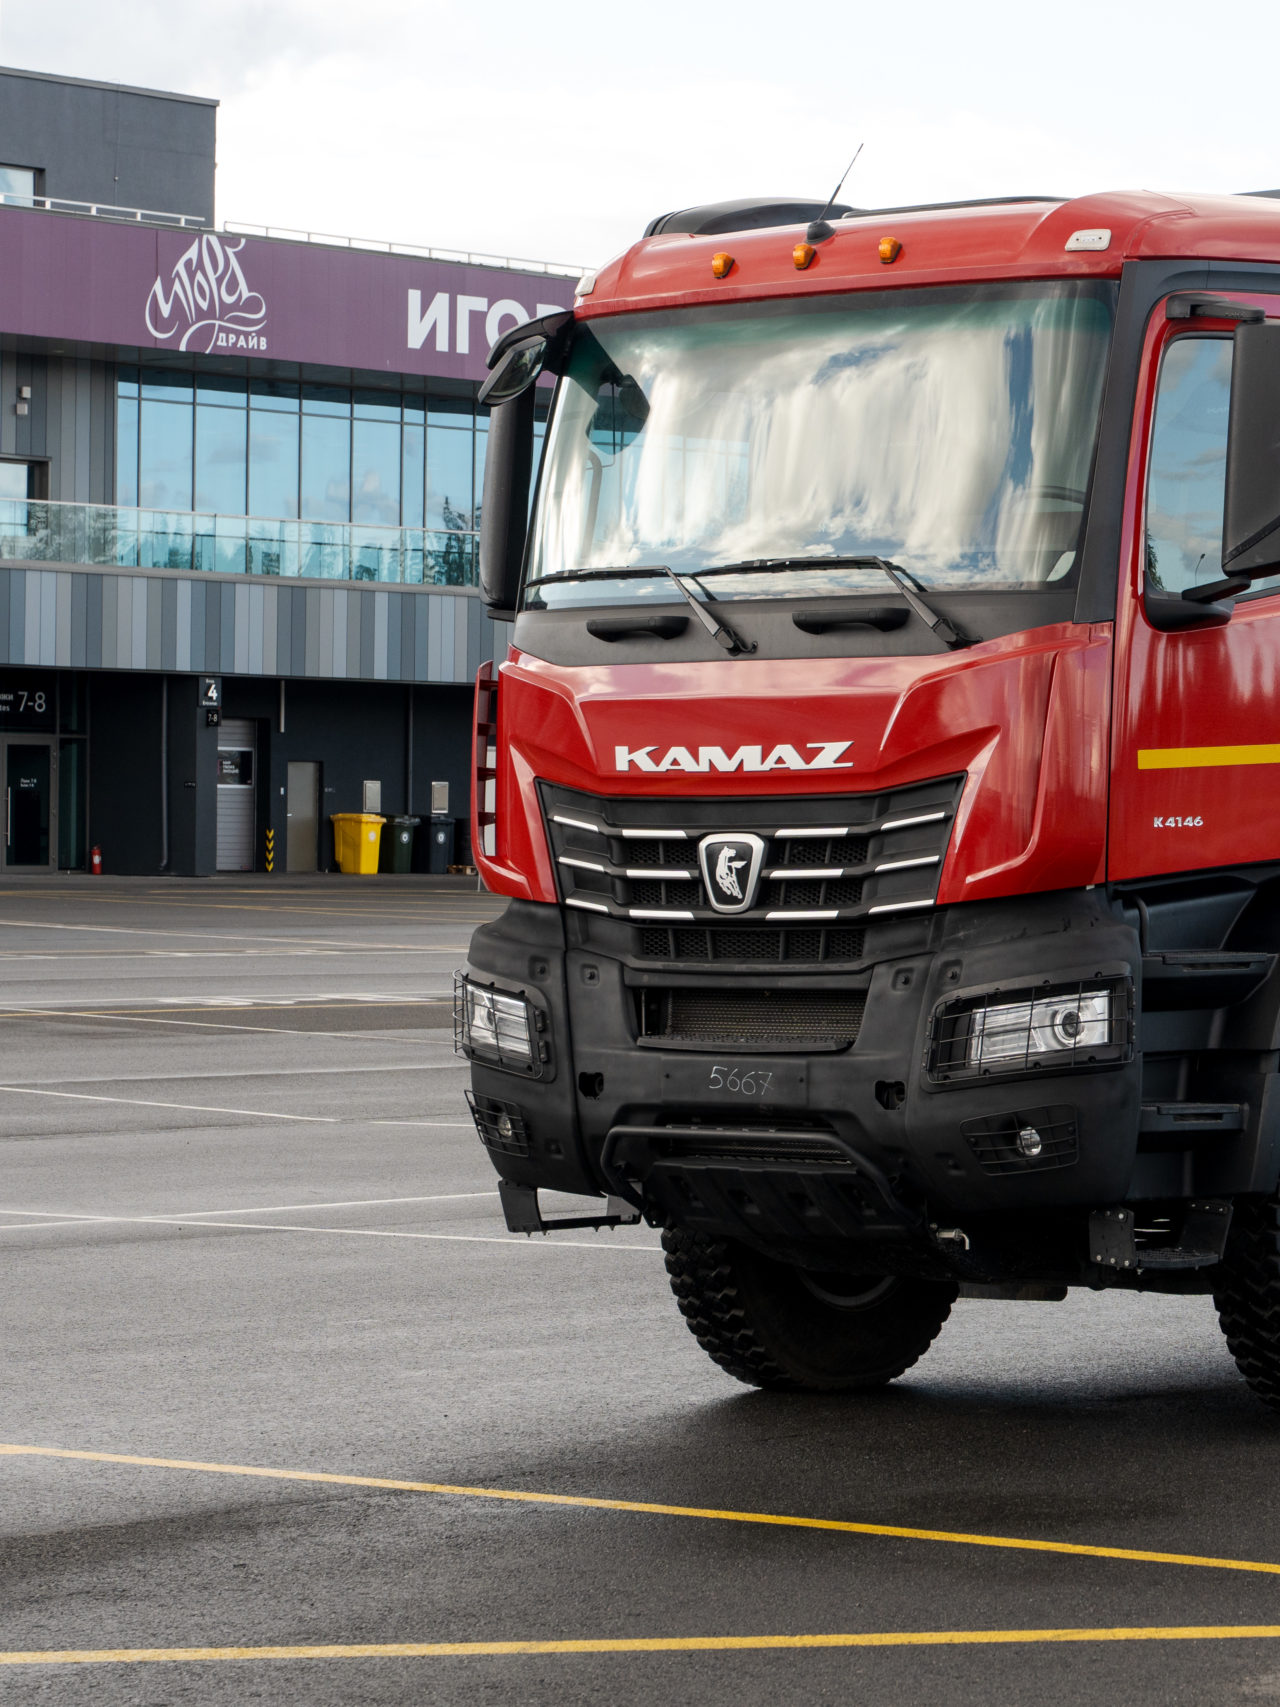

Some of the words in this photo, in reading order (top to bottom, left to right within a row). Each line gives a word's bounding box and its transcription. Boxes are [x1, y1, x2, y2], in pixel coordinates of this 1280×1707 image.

[407, 288, 568, 355] ИГО
[217, 332, 267, 350] ДРАЙВ
[18, 691, 46, 712] 7-8
[207, 683, 218, 700] 4
[614, 741, 855, 772] KAMAZ
[708, 1065, 774, 1096] 5667
